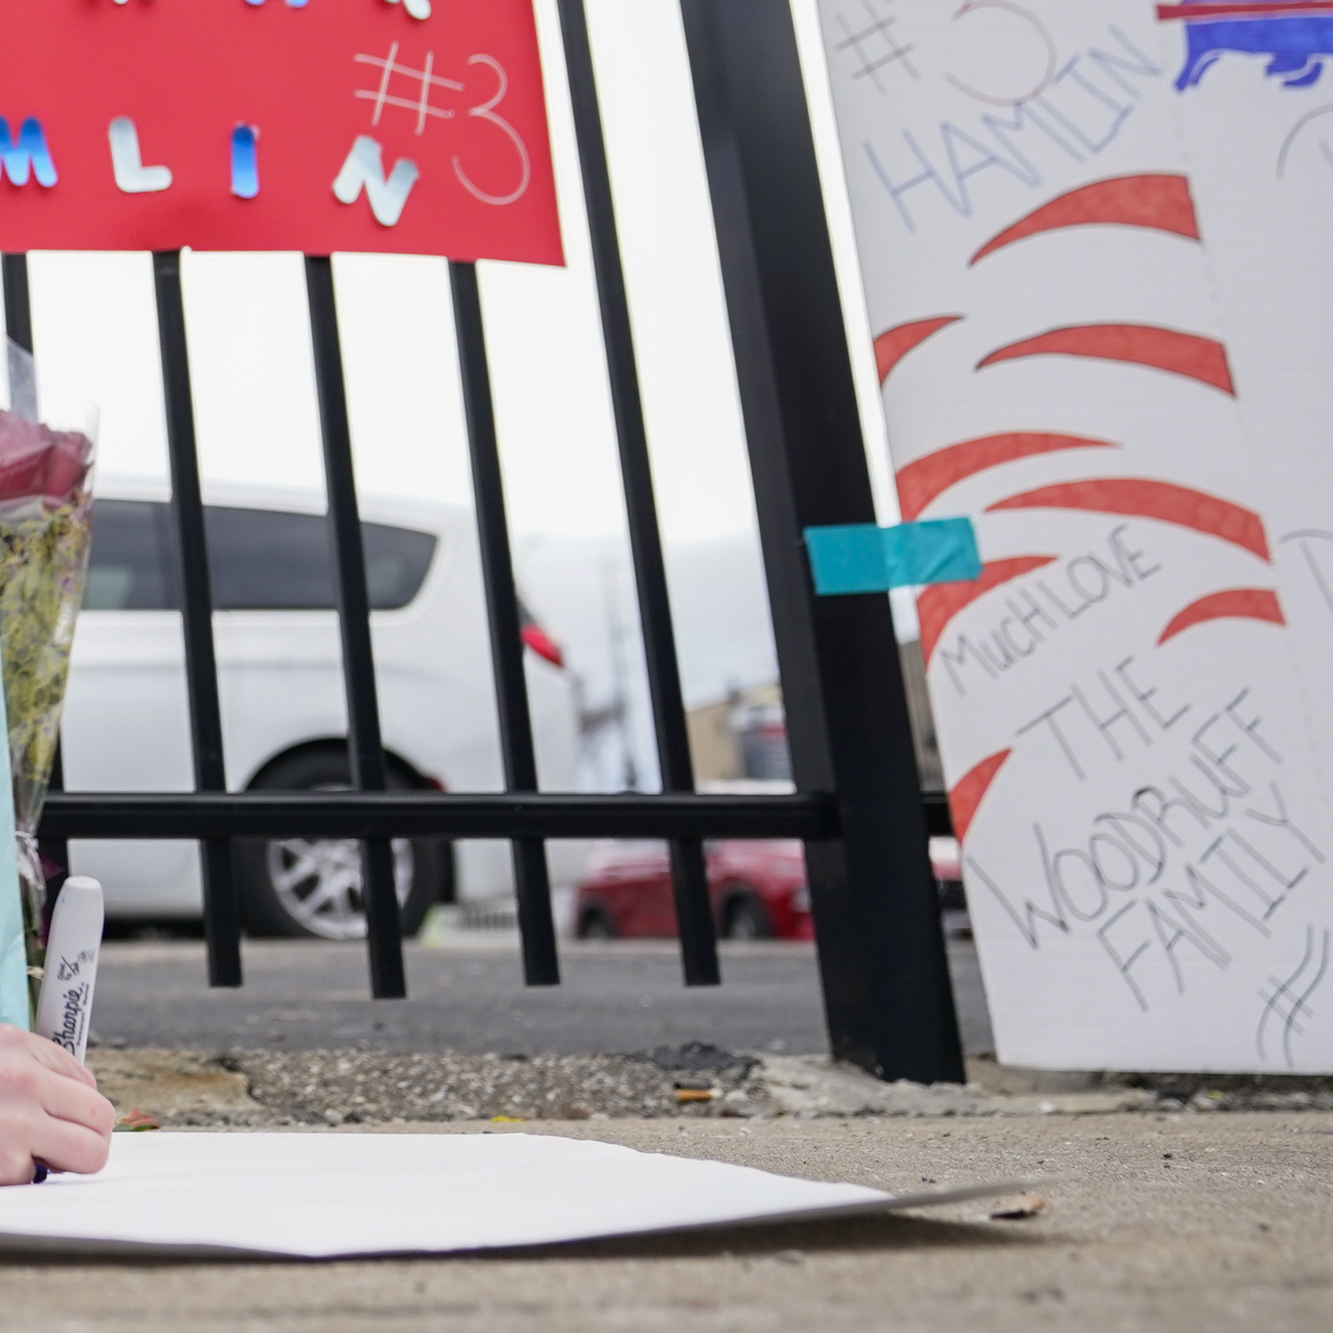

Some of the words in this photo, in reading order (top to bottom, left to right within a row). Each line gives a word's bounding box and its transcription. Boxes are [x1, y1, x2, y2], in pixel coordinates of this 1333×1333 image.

[352, 39, 532, 207] #3
[862, 22, 1163, 234] HAMLIN
[1035, 523, 1164, 620] LOVE
[1014, 655, 1193, 783] THE
[964, 685, 1286, 951] WOODRUFF
[1096, 778, 1327, 1014] FAMILY
[52, 986, 84, 1057] Sharpie
